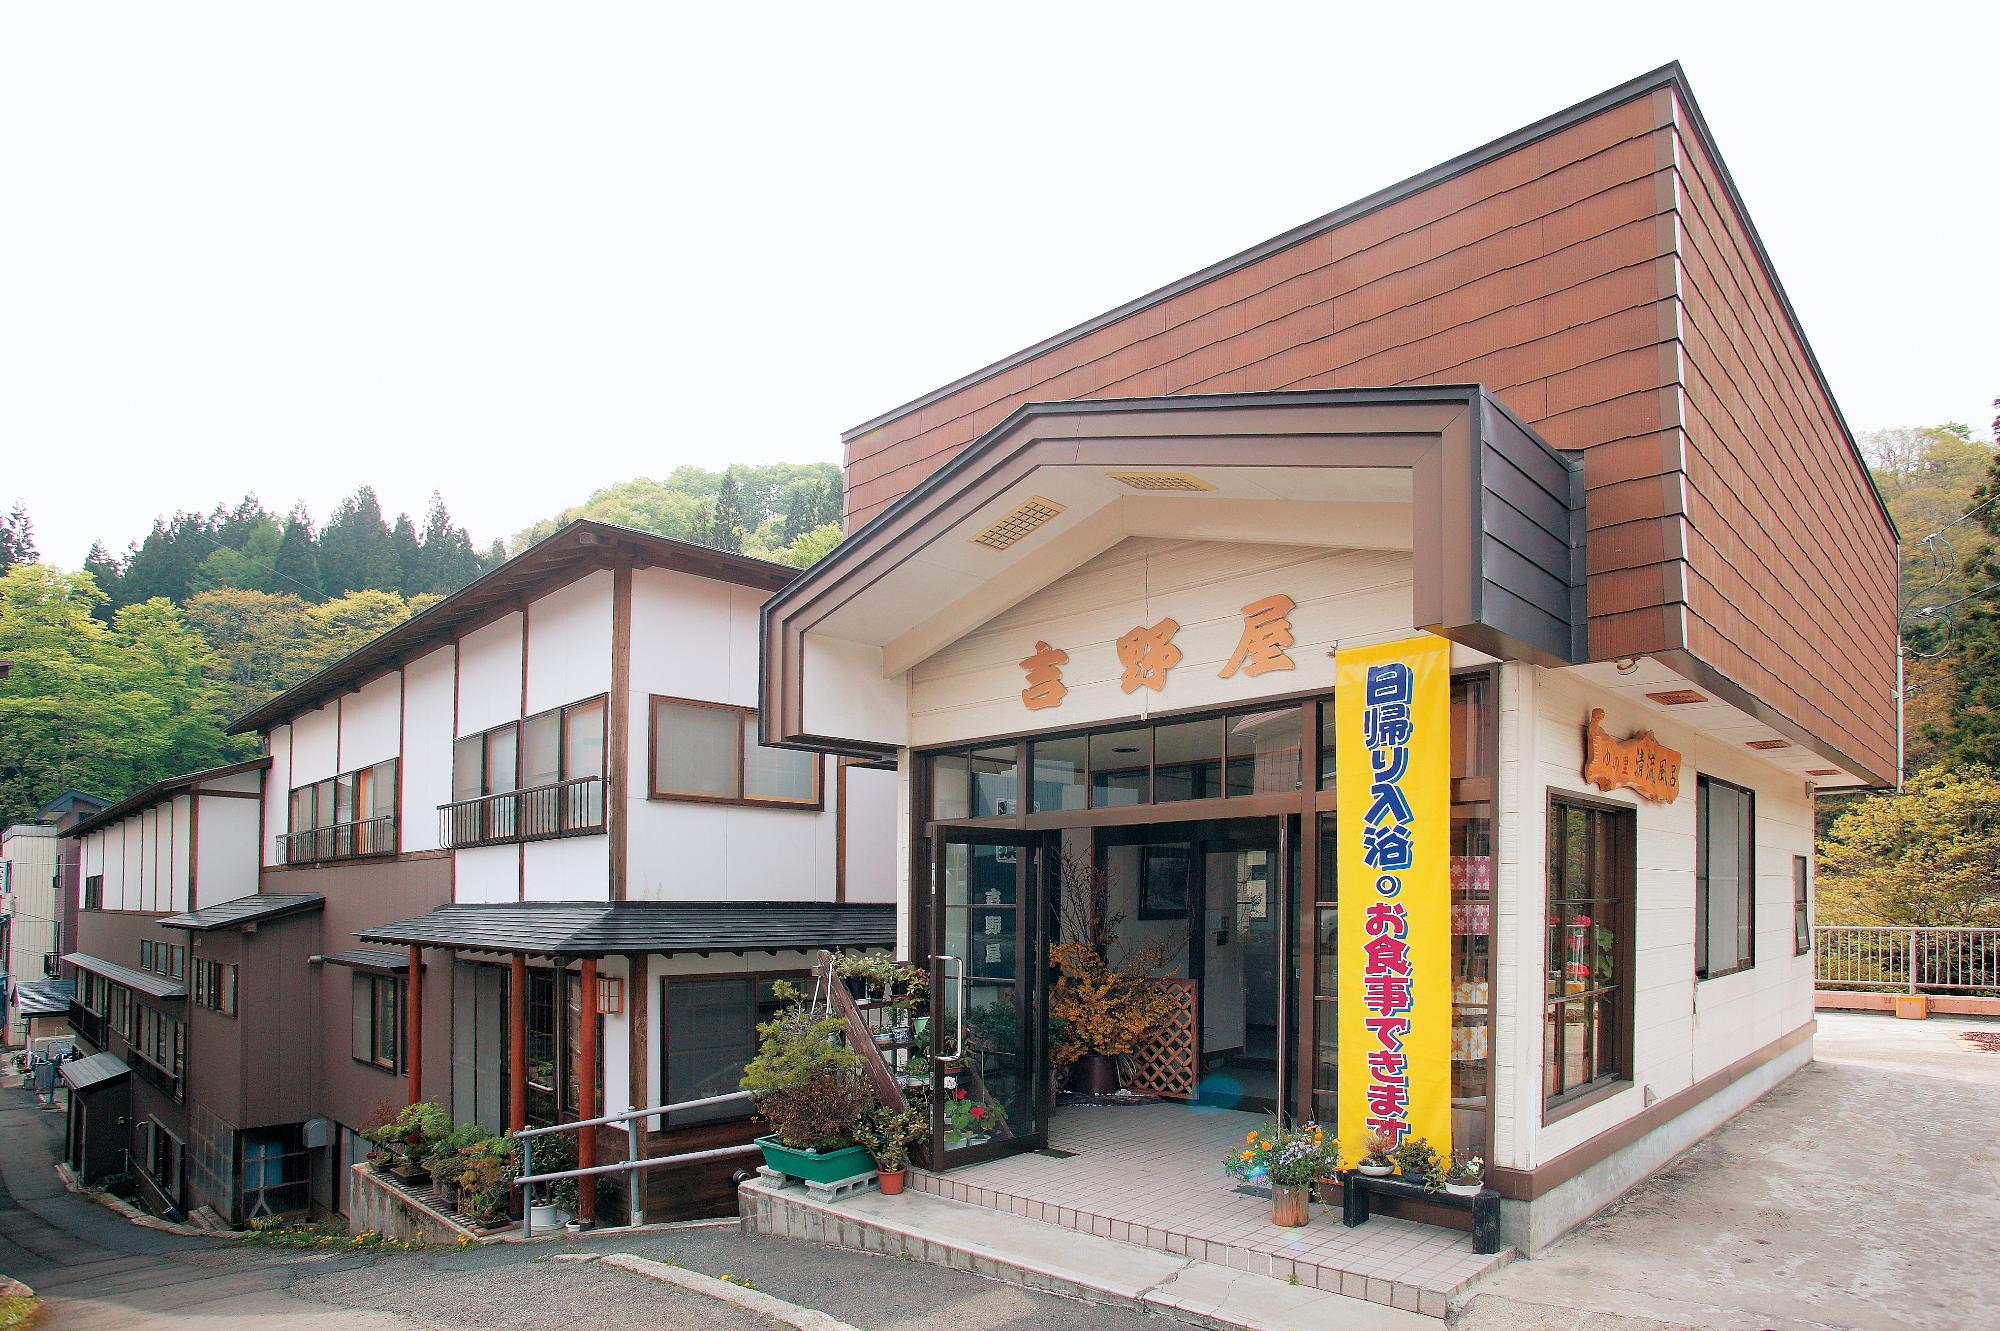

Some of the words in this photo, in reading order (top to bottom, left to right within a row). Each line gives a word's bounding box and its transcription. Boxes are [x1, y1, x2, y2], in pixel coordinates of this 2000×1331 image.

[1019, 594, 1296, 711] 吉野屋
[985, 888, 1002, 963] 吉野屋
